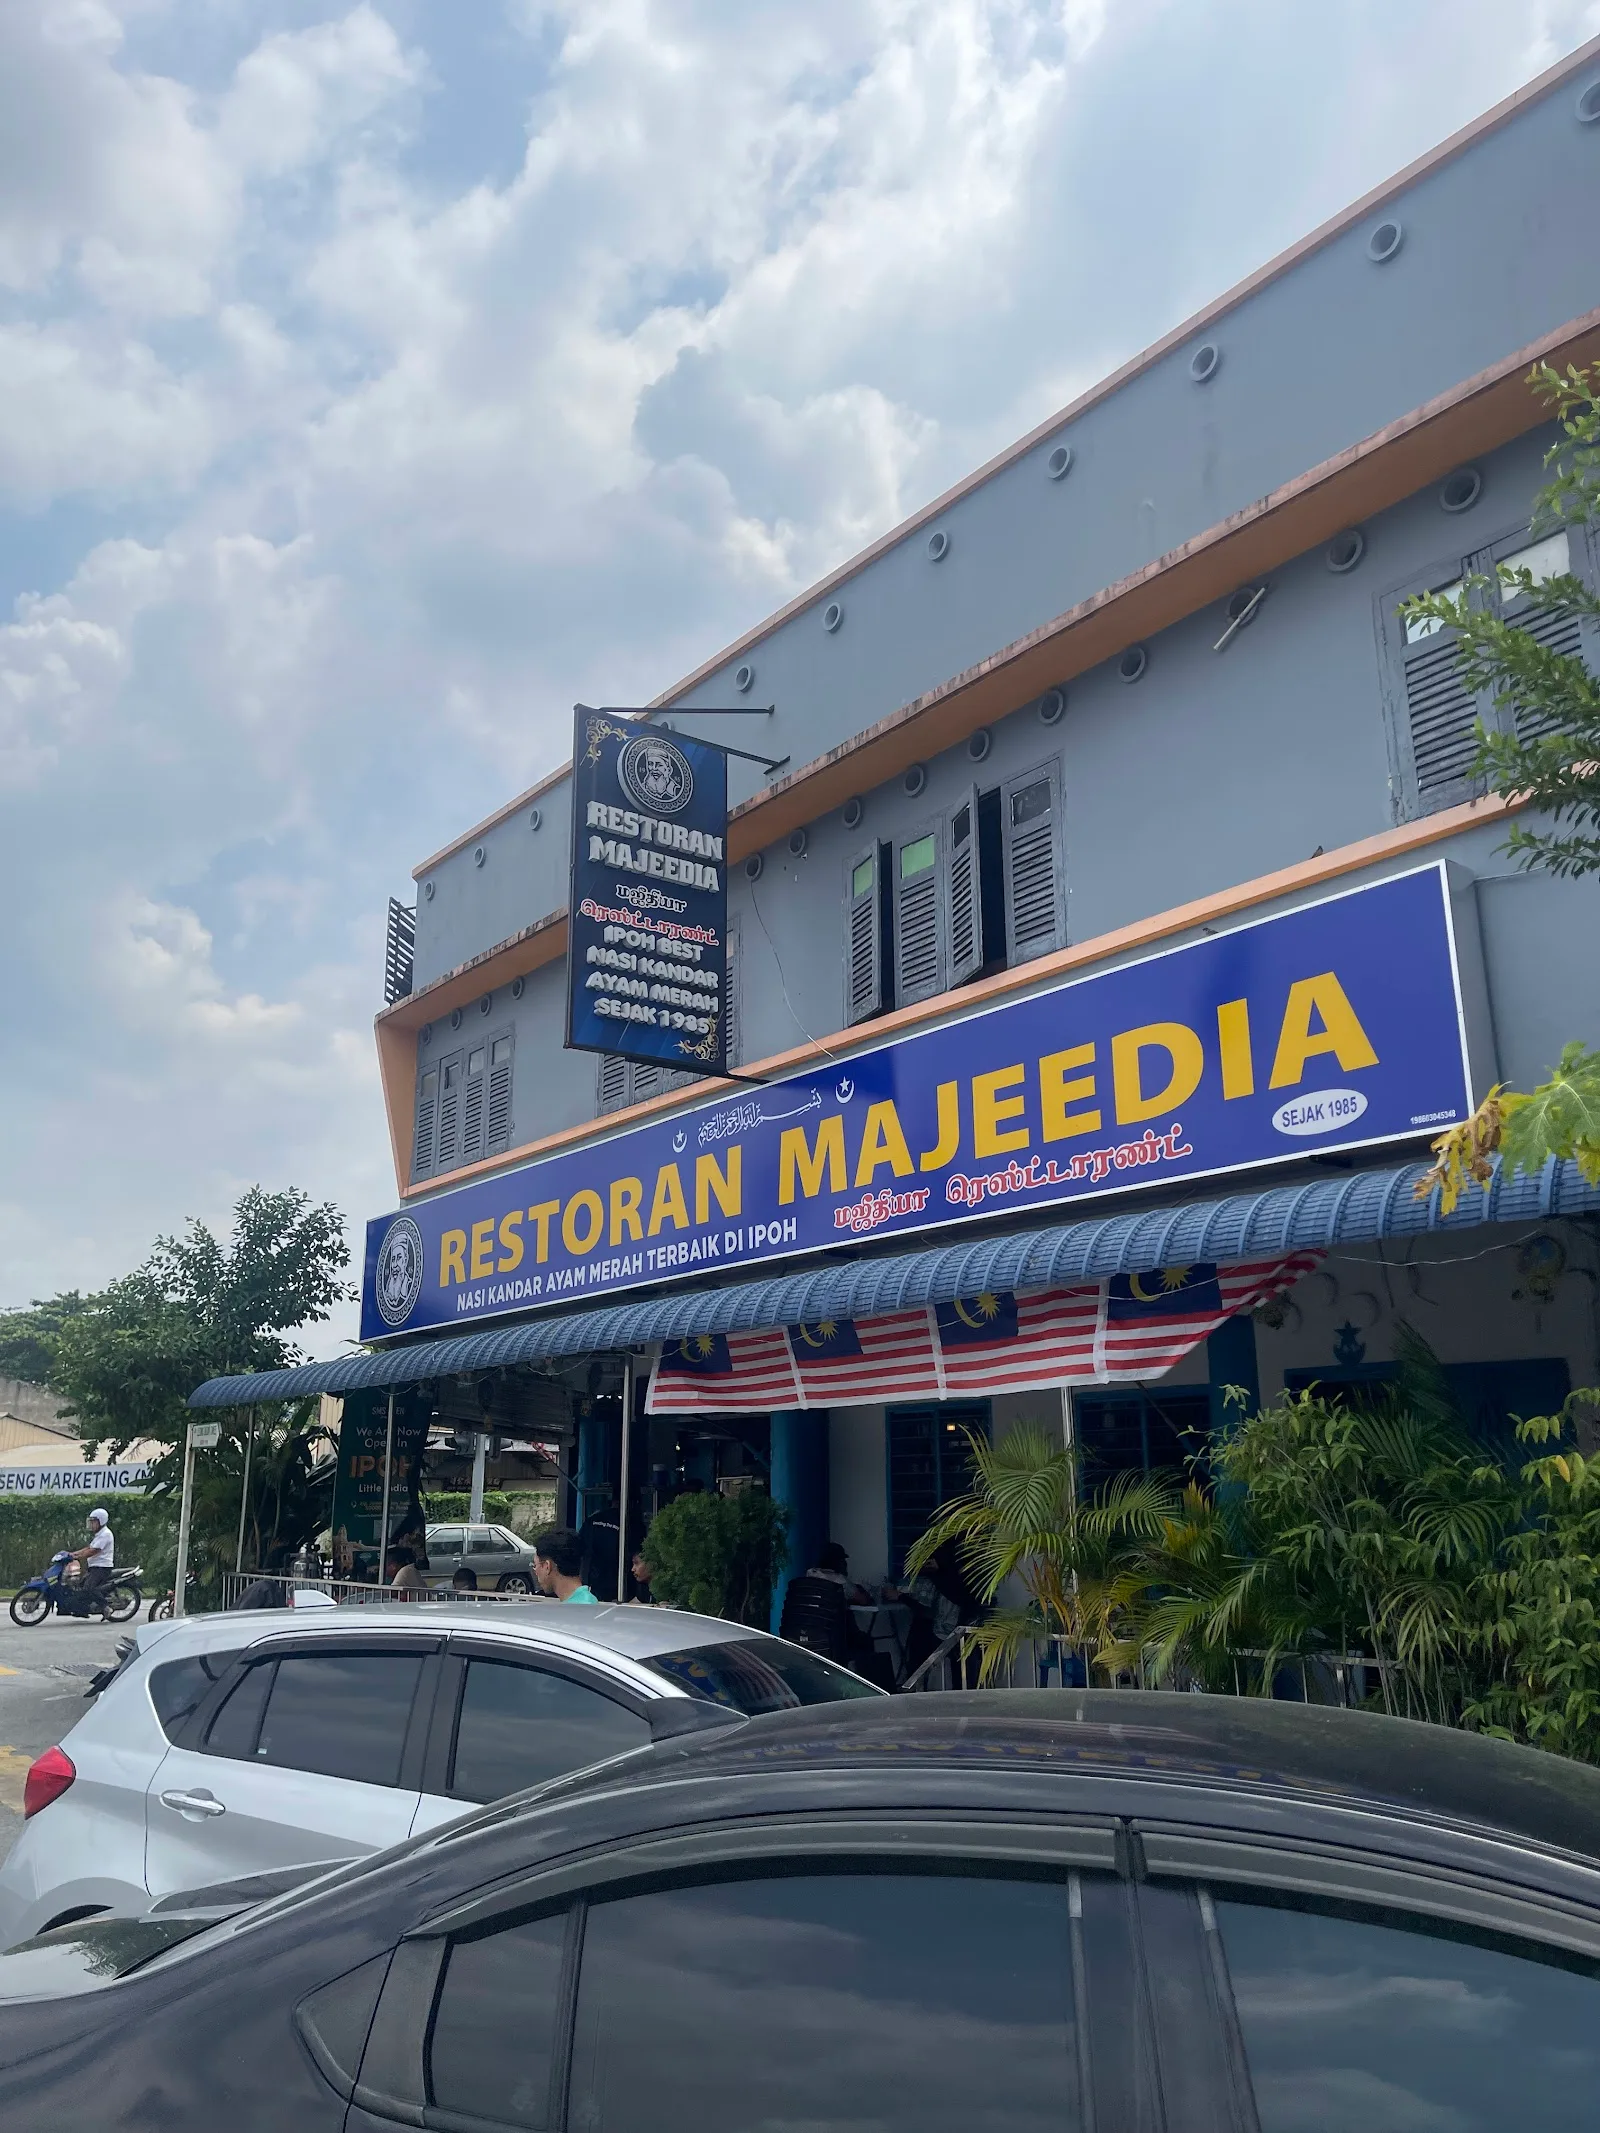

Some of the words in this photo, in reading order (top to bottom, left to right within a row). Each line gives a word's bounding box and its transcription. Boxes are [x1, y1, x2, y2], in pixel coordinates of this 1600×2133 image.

[586, 800, 723, 861] RESTORAN
[588, 835, 720, 894] MAJEEDIA
[603, 925, 656, 952] IPOH
[656, 937, 704, 962] BEST
[586, 945, 638, 973] NASI
[637, 957, 719, 989] KANDAR
[585, 971, 649, 999] AYAM
[648, 984, 719, 1013] MERAH
[594, 997, 657, 1025] SEJAK
[658, 1009, 711, 1035] 1985
[439, 1145, 742, 1288] RESTORAN
[779, 971, 1380, 1206] MAJEEDIA
[1281, 1103, 1325, 1128] SEJAK
[1328, 1096, 1358, 1118] 1985
[456, 1289, 486, 1312] NASI
[488, 1275, 542, 1306] KANDAR
[546, 1265, 586, 1294] AYAM
[589, 1252, 643, 1284] MERAH
[646, 1233, 721, 1271] TERBAIK
[724, 1228, 744, 1254] DI
[748, 1217, 797, 1250] IPOH
[356, 1427, 373, 1436] We
[375, 1427, 388, 1436] Ar
[397, 1426, 421, 1436] Now
[364, 1438, 388, 1449] Ope
[397, 1438, 408, 1447] In
[40, 1470, 129, 1490] MARKETING
[359, 1484, 382, 1493] Little
